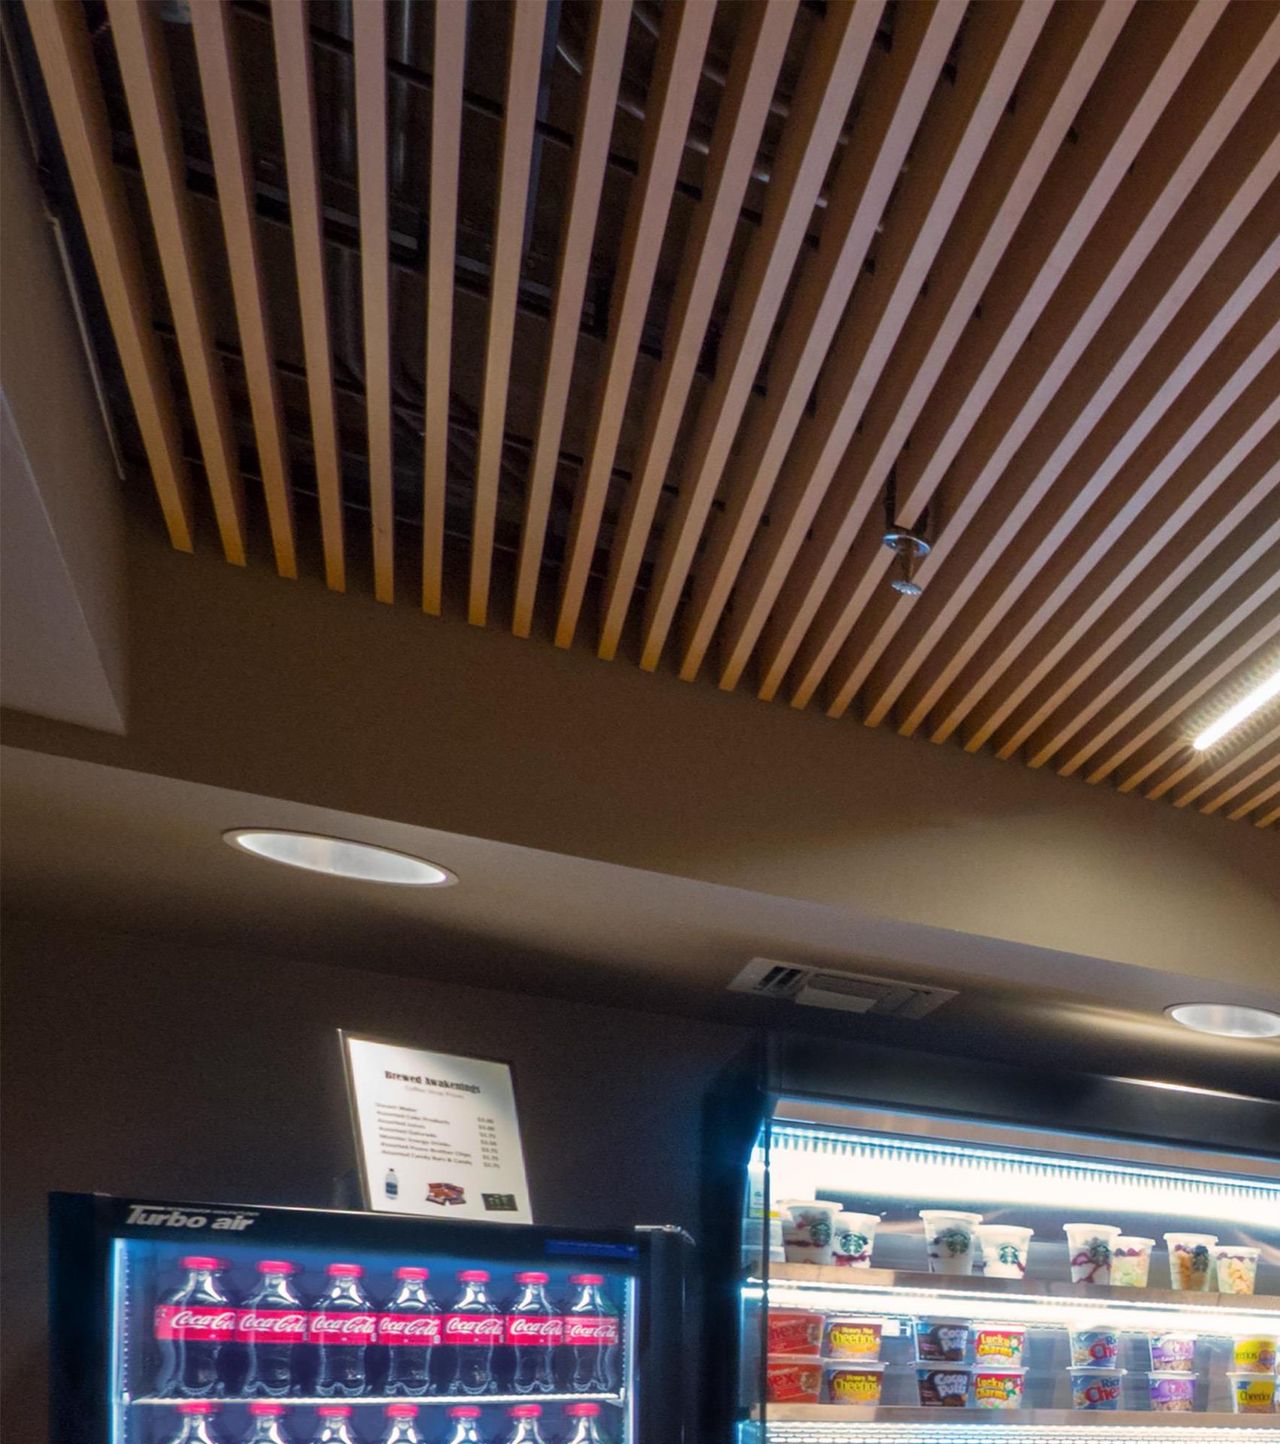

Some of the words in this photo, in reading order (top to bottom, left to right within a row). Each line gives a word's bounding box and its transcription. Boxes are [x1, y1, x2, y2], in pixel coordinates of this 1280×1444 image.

[385, 1070, 422, 1084] Brewed
[425, 1077, 481, 1094] Awakenings
[126, 1205, 207, 1228] Turbo
[211, 1215, 255, 1231] air
[312, 1315, 375, 1333] Coca-Cola
[379, 1317, 438, 1335] Coca-Cola
[831, 1331, 876, 1347] Cheerios
[981, 1333, 1010, 1348] Lucky
[978, 1345, 1013, 1358] Charms
[834, 1378, 878, 1394] Cheerios
[976, 1377, 1005, 1391] Lucky
[976, 1388, 1009, 1401] Charms
